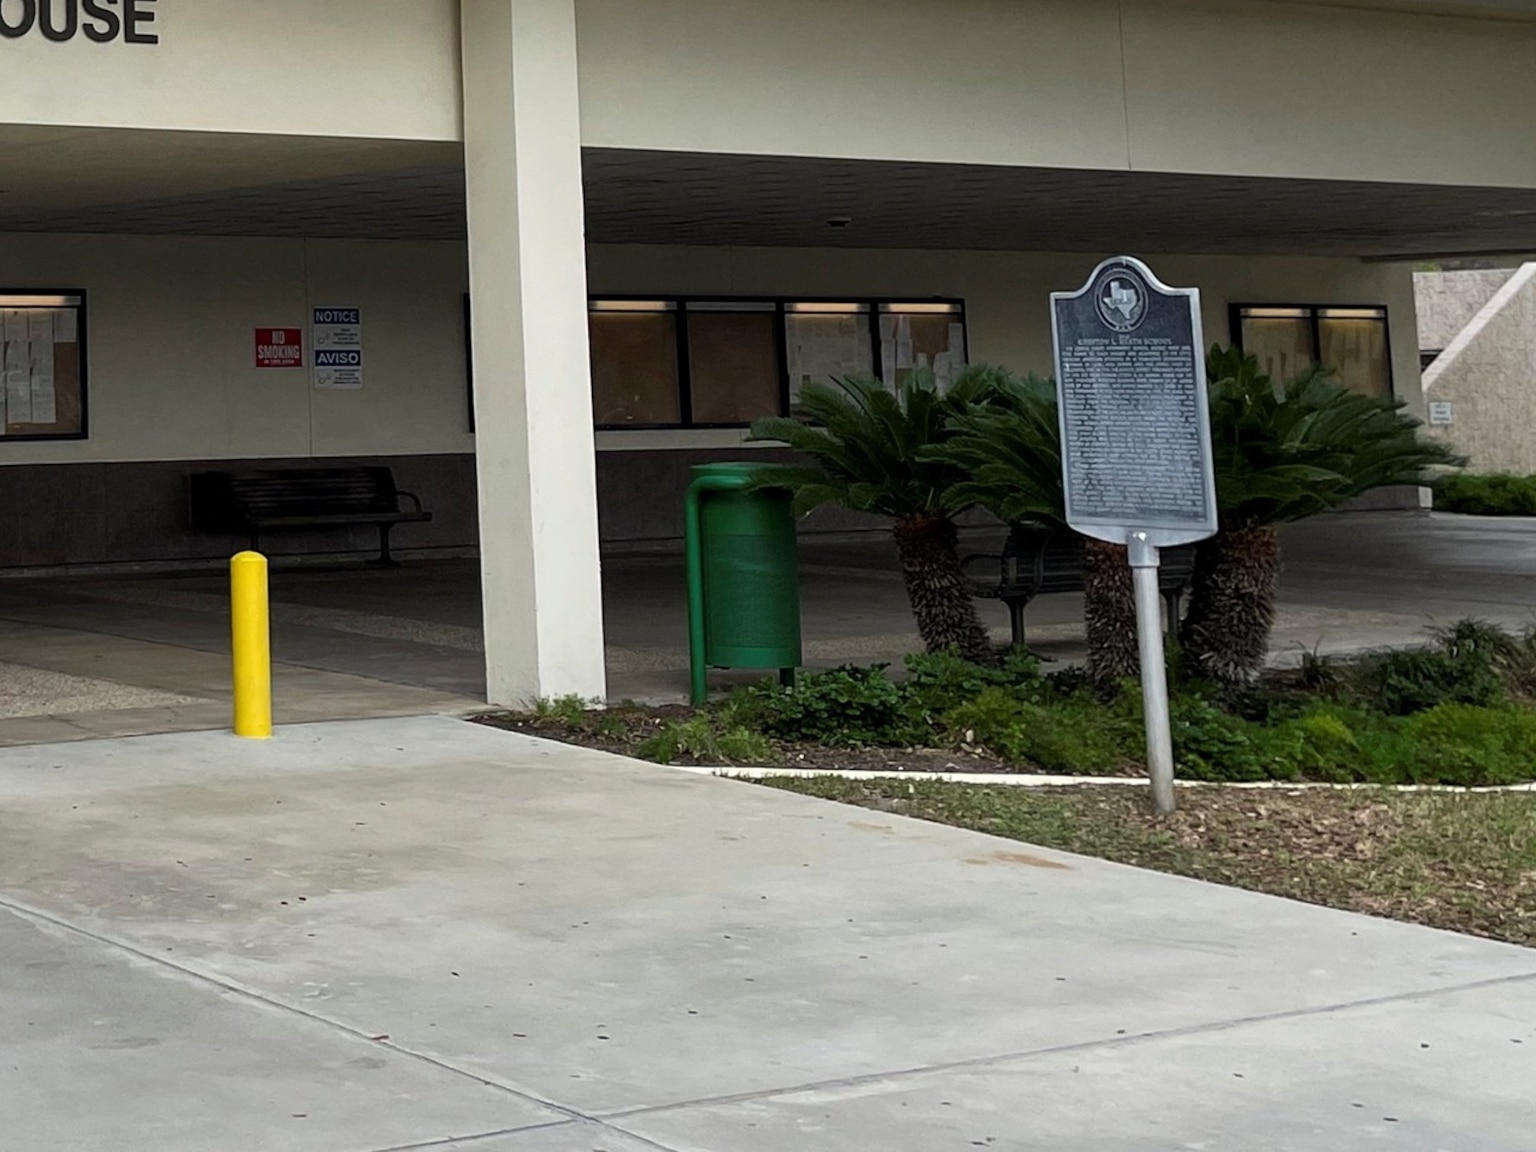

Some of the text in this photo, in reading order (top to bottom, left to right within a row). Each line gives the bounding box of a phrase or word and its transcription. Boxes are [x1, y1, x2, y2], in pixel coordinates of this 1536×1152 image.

[315, 311, 358, 322] NOTICE
[272, 330, 285, 344] NO
[258, 345, 300, 359] SMOKING
[317, 352, 359, 364] AVISO
